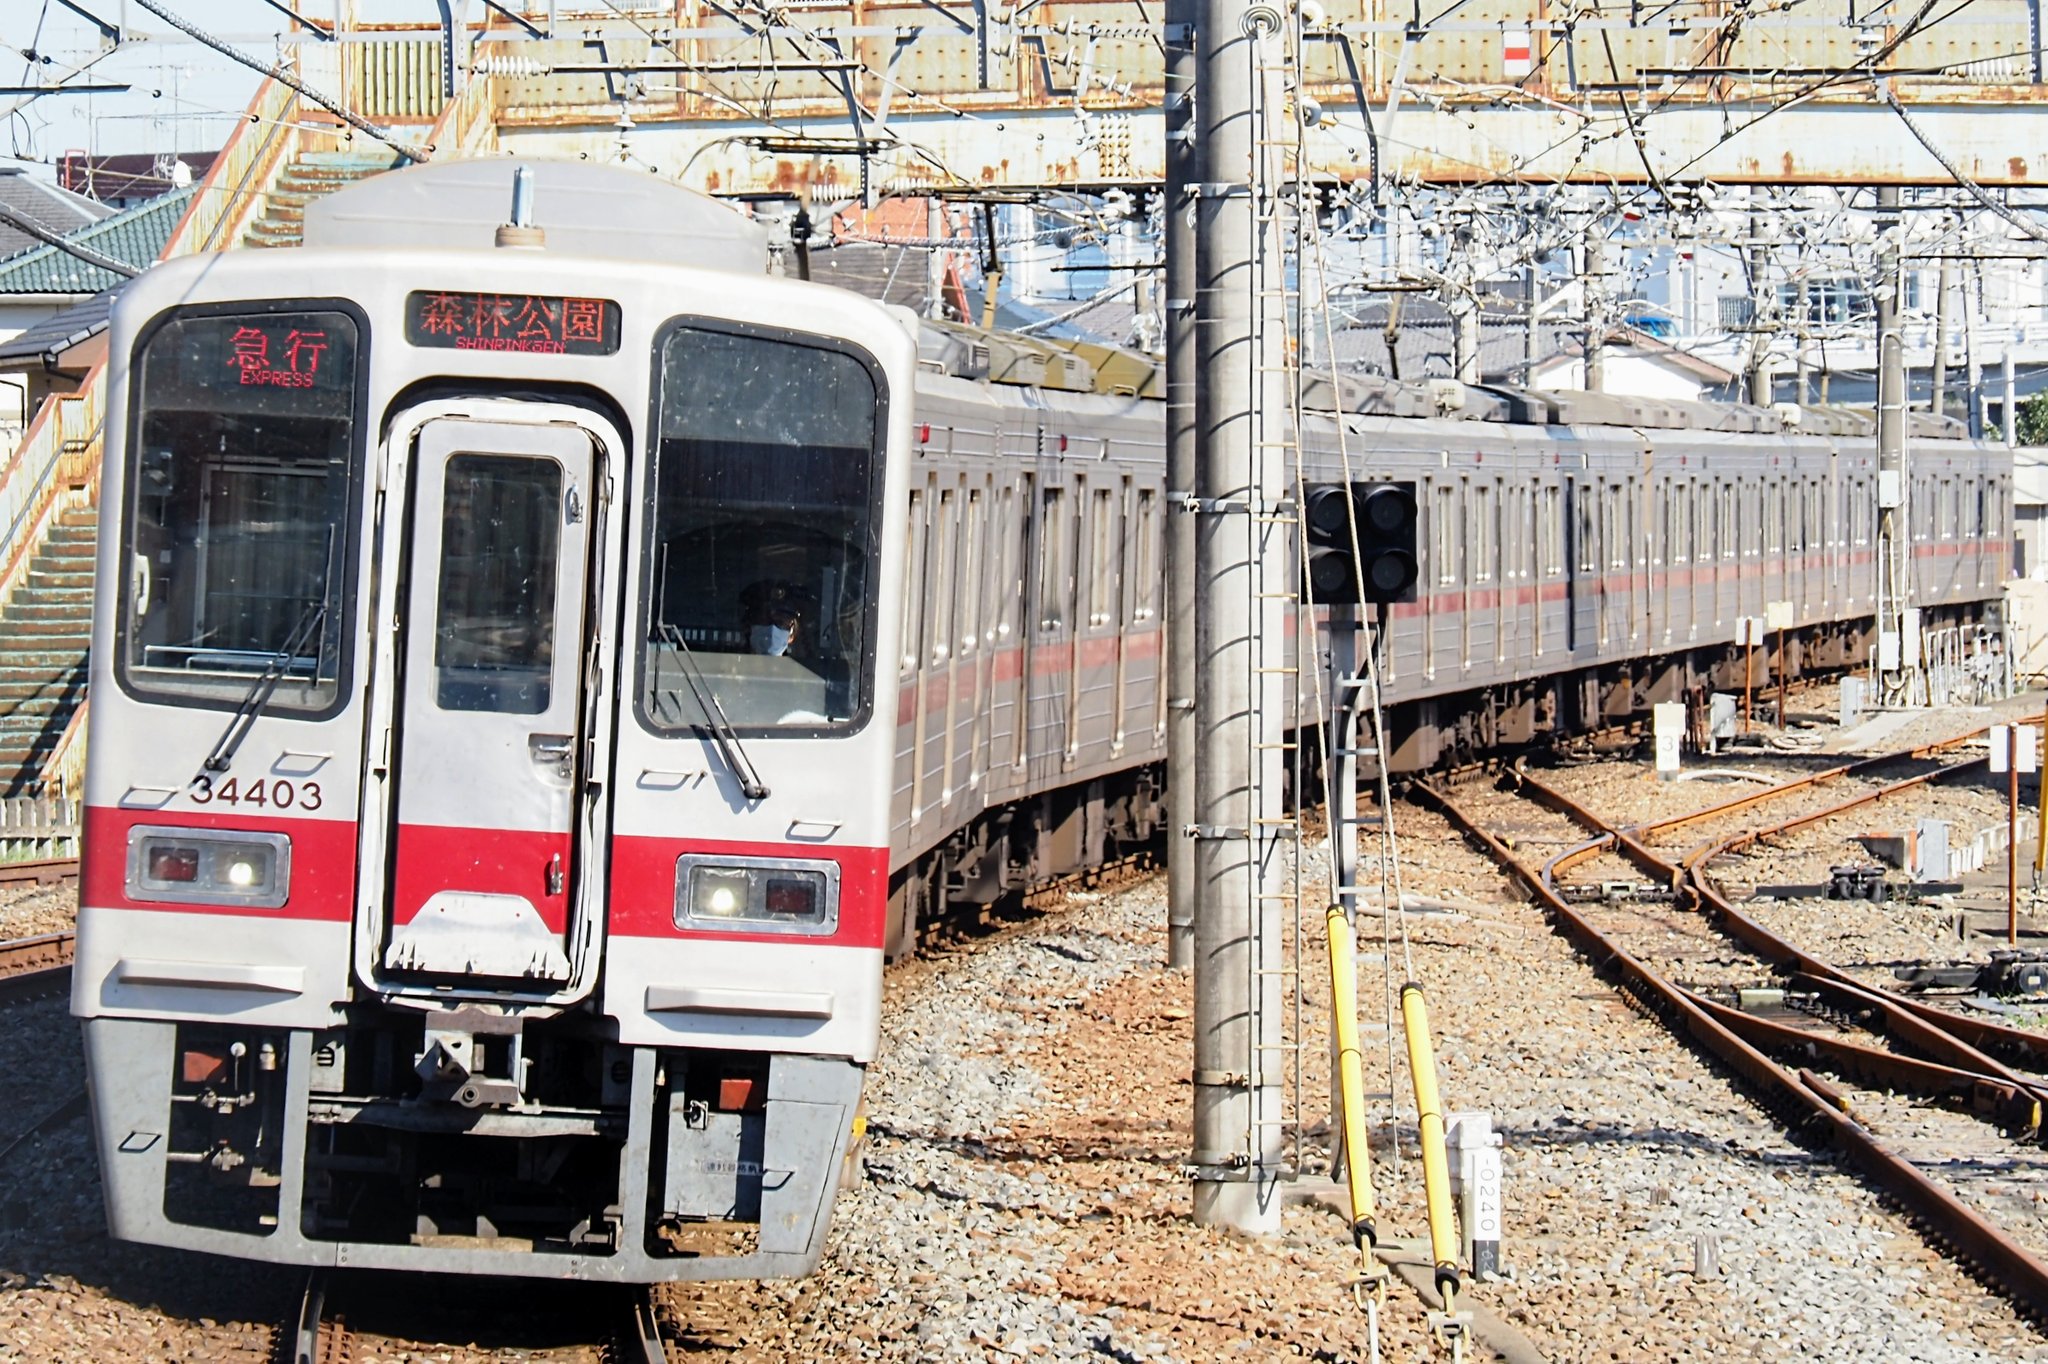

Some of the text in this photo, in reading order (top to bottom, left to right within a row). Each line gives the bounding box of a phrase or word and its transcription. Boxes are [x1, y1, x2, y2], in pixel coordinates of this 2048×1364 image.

[421, 291, 605, 343] 森林公園
[226, 326, 328, 372] 急行
[240, 370, 314, 388] EXPRESS
[190, 775, 322, 811] 34403
